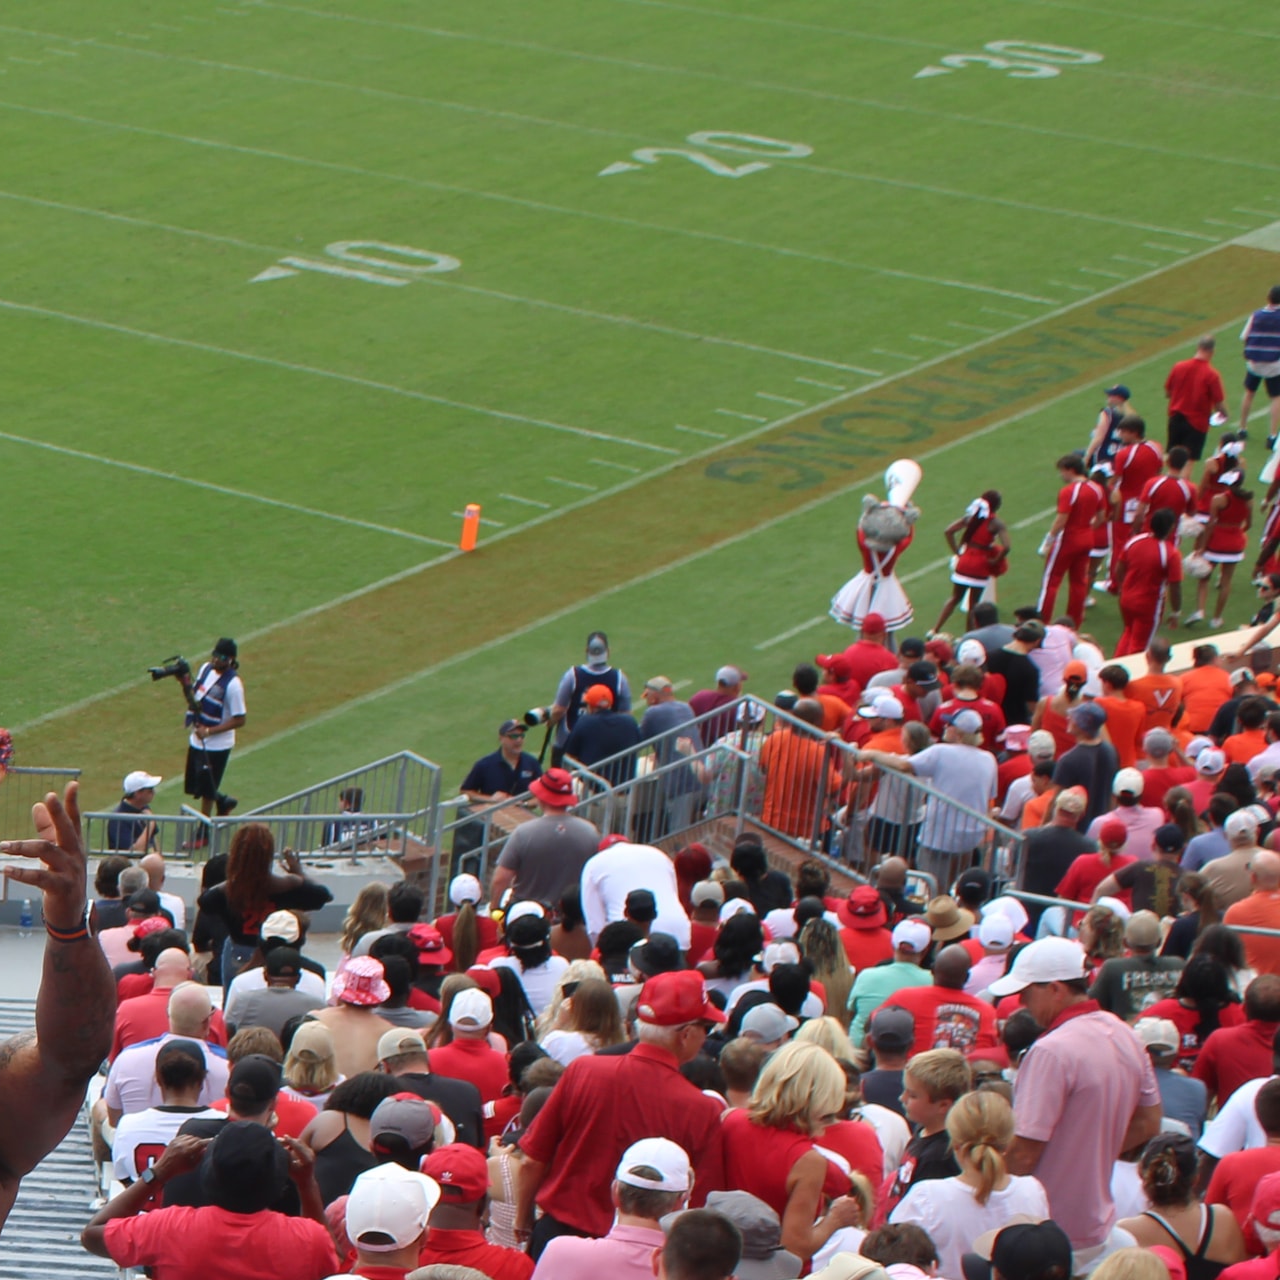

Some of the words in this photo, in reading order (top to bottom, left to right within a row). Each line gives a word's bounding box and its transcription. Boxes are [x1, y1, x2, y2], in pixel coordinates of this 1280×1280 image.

[940, 40, 1105, 79] 30
[630, 129, 815, 178] 20
[277, 239, 462, 287] 10
